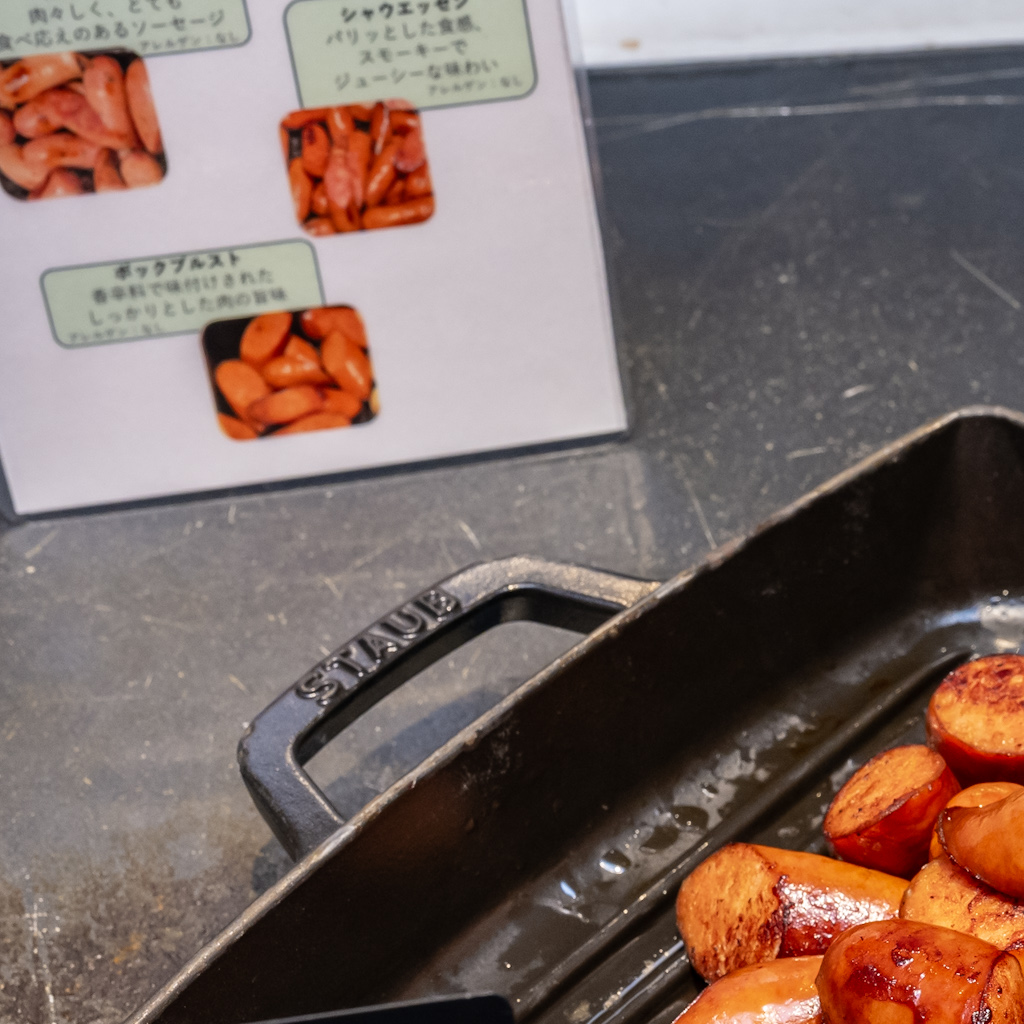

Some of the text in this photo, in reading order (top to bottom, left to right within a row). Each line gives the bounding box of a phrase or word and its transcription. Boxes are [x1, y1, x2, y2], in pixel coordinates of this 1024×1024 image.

[359, 38, 468, 66] スモーキーで
[334, 59, 499, 91] ジューシーな味わい
[295, 586, 462, 708] STAUB
